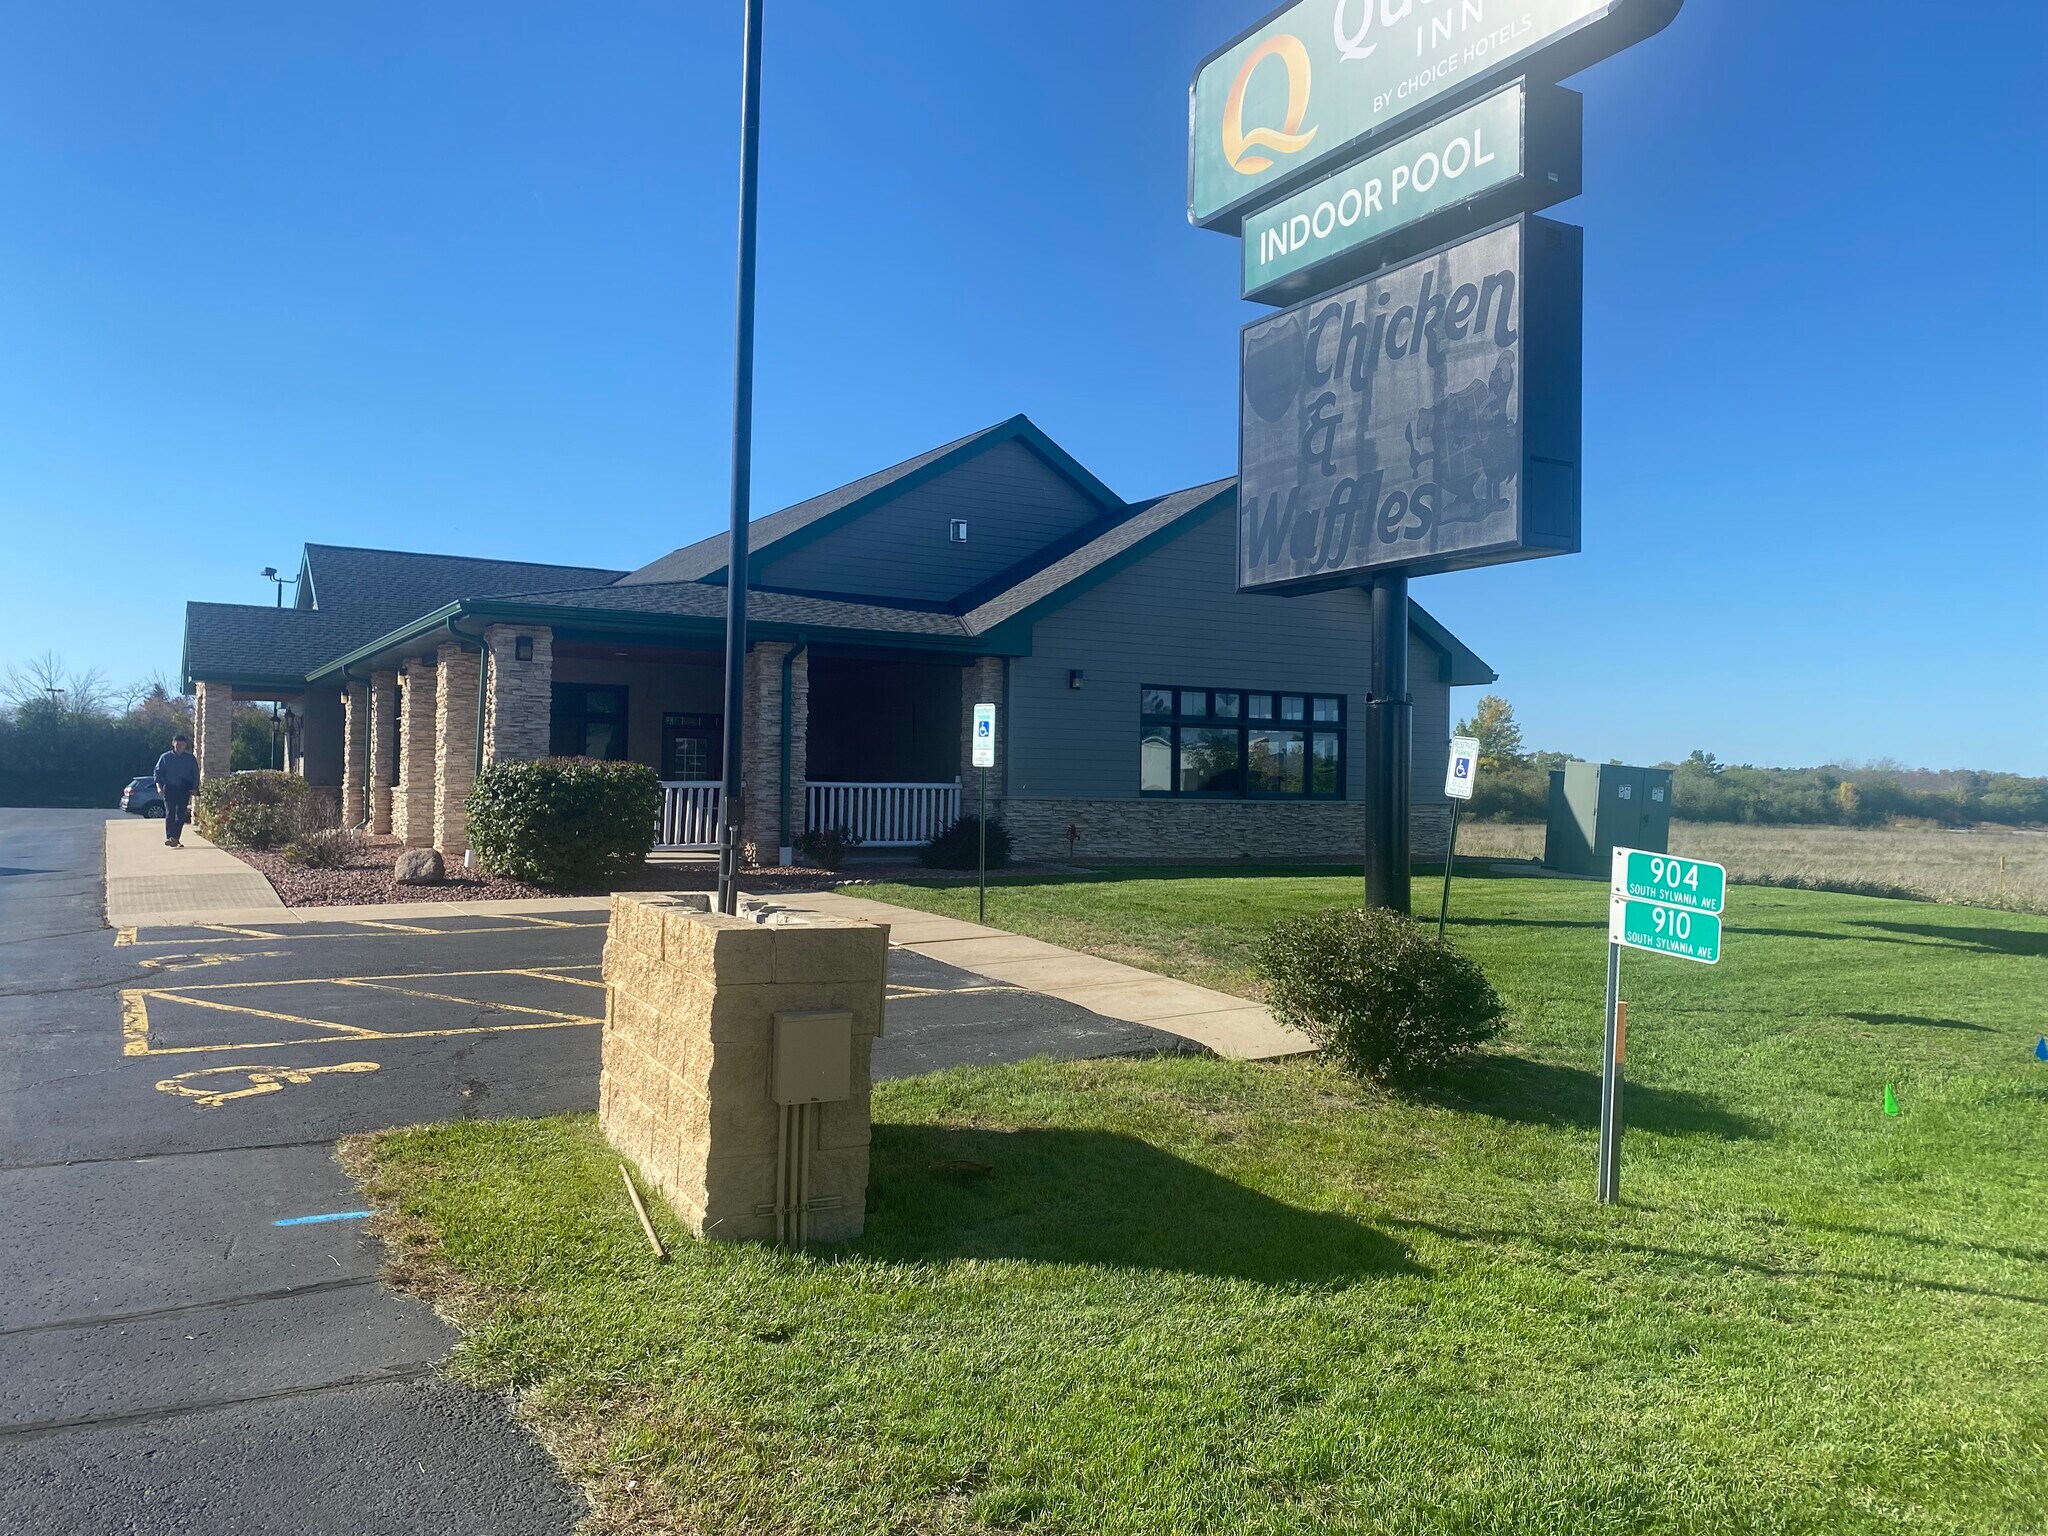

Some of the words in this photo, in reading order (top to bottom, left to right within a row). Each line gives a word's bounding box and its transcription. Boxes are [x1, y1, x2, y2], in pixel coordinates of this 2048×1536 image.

[1373, 89, 1393, 113] BY
[1397, 53, 1458, 99] CHOICE
[1463, 13, 1532, 65] HOTELS
[1417, 0, 1483, 57] INN
[1259, 177, 1382, 265] INDOOR
[1391, 127, 1495, 205] POOL
[1305, 269, 1517, 392] Chicken
[1302, 391, 1343, 477] &
[1242, 469, 1438, 573] Waffles
[1629, 882, 1656, 898] SOUTH
[1659, 888, 1698, 906] SYLVANIA
[1700, 896, 1717, 910] AVE
[1650, 857, 1699, 892] 904
[1627, 930, 1653, 946] SOUTH
[1656, 937, 1694, 955] SYLVANIA
[1697, 945, 1713, 959] AVE
[1651, 906, 1691, 940] 910
